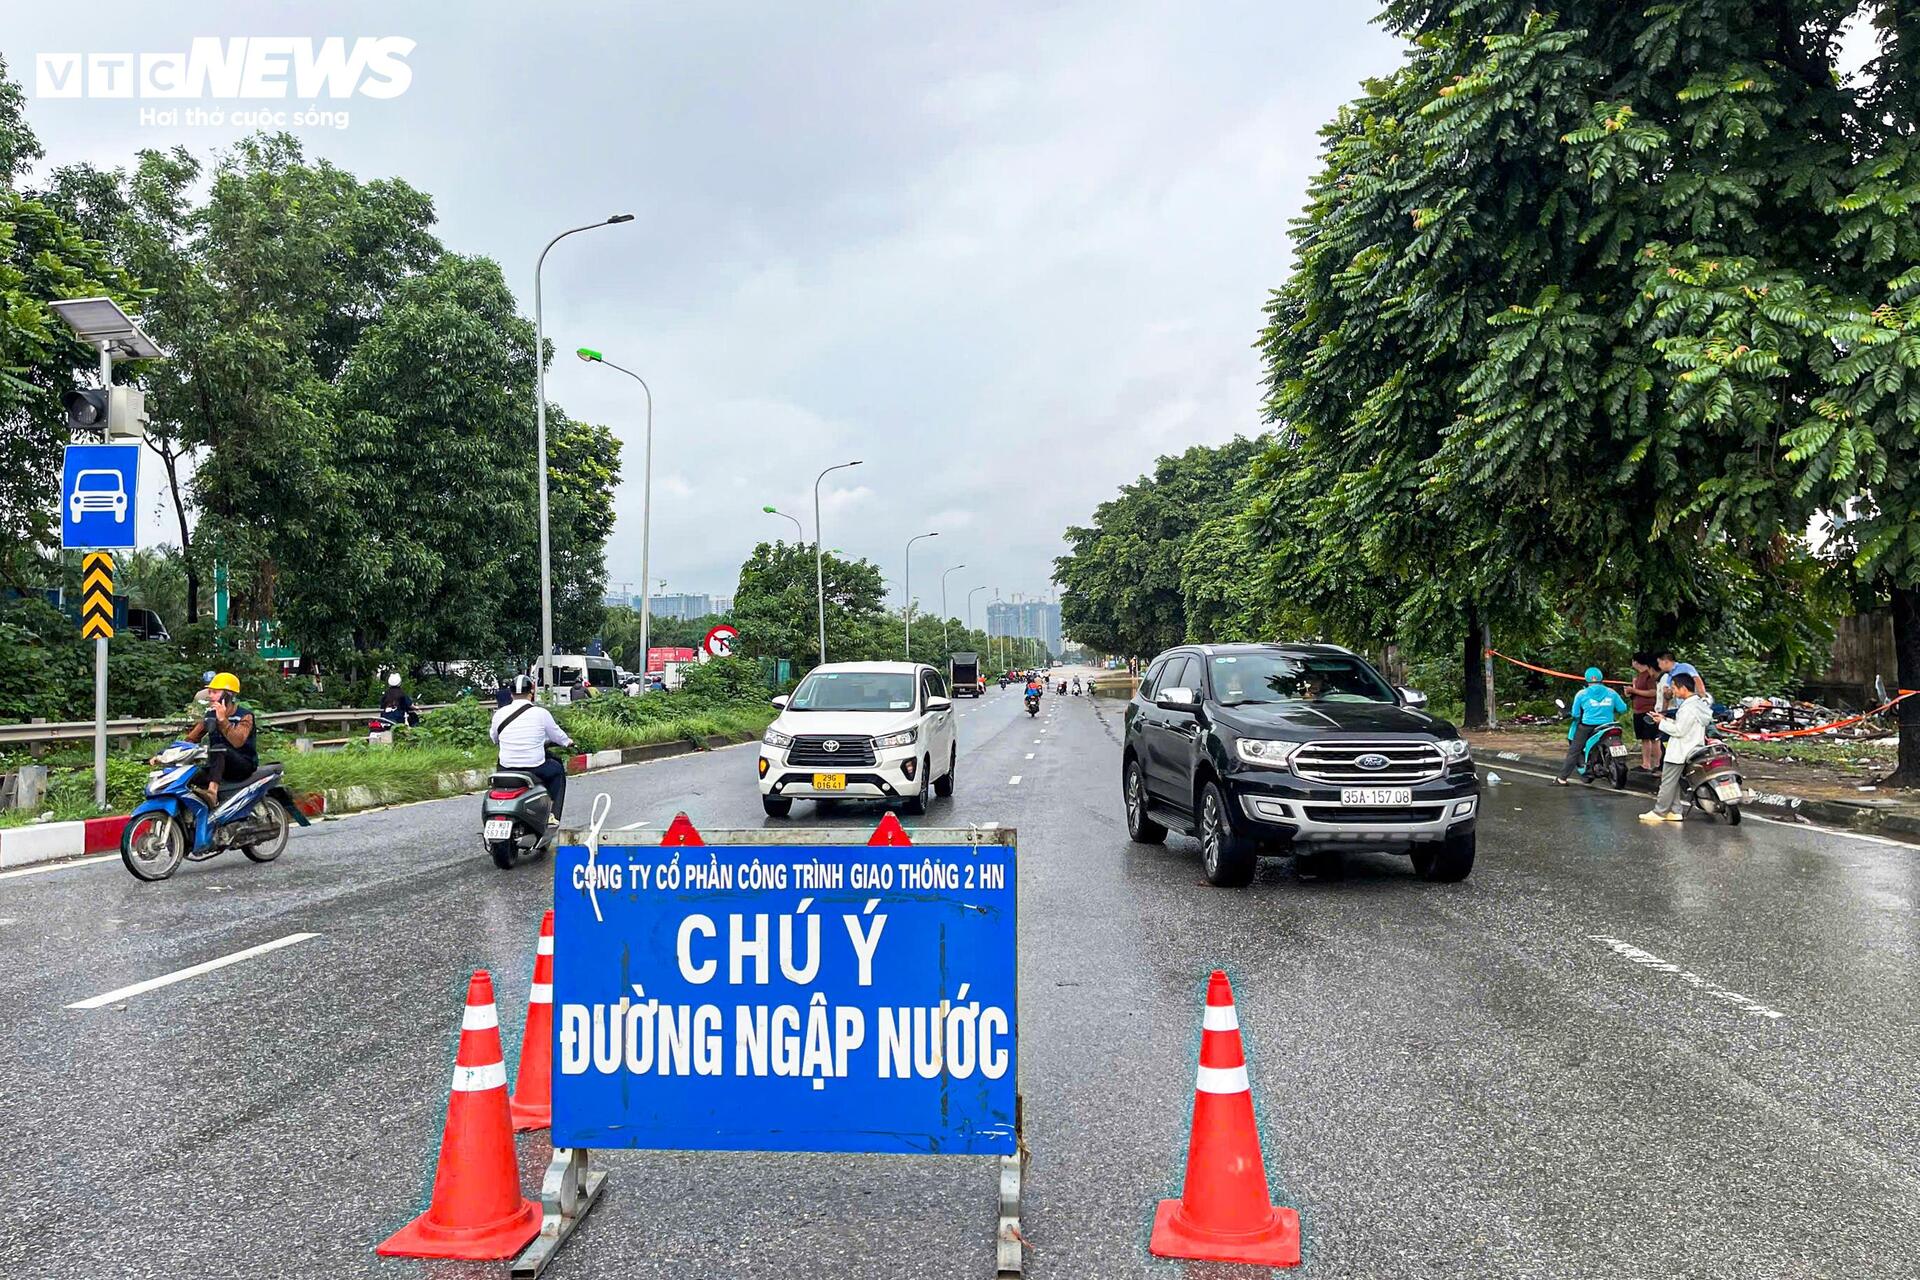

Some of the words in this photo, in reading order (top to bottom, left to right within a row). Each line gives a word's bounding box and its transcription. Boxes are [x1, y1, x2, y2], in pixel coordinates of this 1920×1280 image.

[1343, 790, 1410, 804] 35A-157.08
[628, 864, 651, 890] TY
[656, 852, 680, 890] CỔ
[685, 853, 733, 890] PHẦN
[737, 858, 787, 890] CÔNG
[793, 858, 843, 889] TRÌNH
[850, 863, 893, 890] GIAO
[899, 858, 959, 889] THÔNG
[964, 864, 975, 889] 2
[979, 864, 1004, 889] HN
[676, 897, 821, 985] CHÚ
[842, 898, 888, 986] Ý
[560, 984, 723, 1076] ĐƯỜNG
[734, 992, 865, 1090] NGẬP
[878, 983, 1009, 1080] NƯỚC
